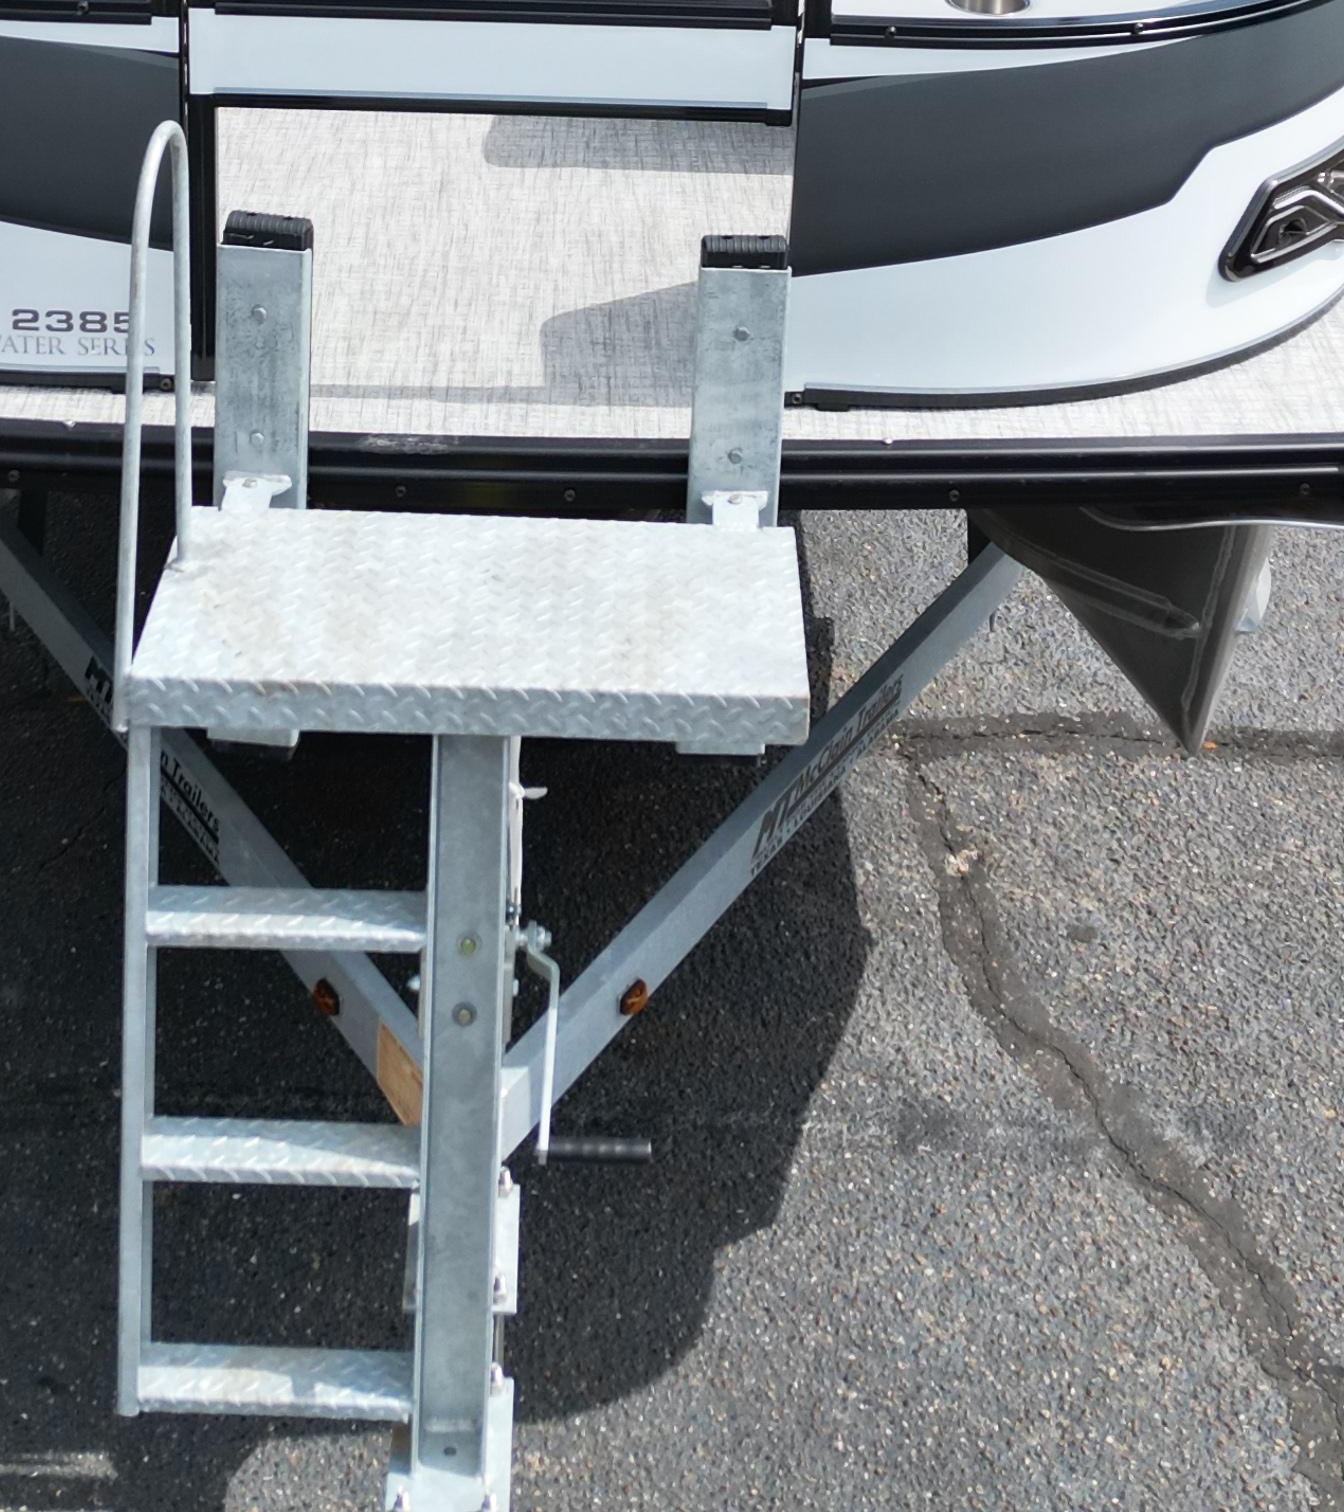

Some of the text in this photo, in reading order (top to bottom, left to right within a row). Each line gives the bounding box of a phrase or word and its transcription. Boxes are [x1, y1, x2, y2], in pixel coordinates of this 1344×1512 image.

[11, 308, 130, 333] 2385
[76, 336, 156, 357] SERIS
[791, 726, 854, 803] McClain
[858, 672, 904, 734] Trailers
[172, 757, 220, 834] Trailers
